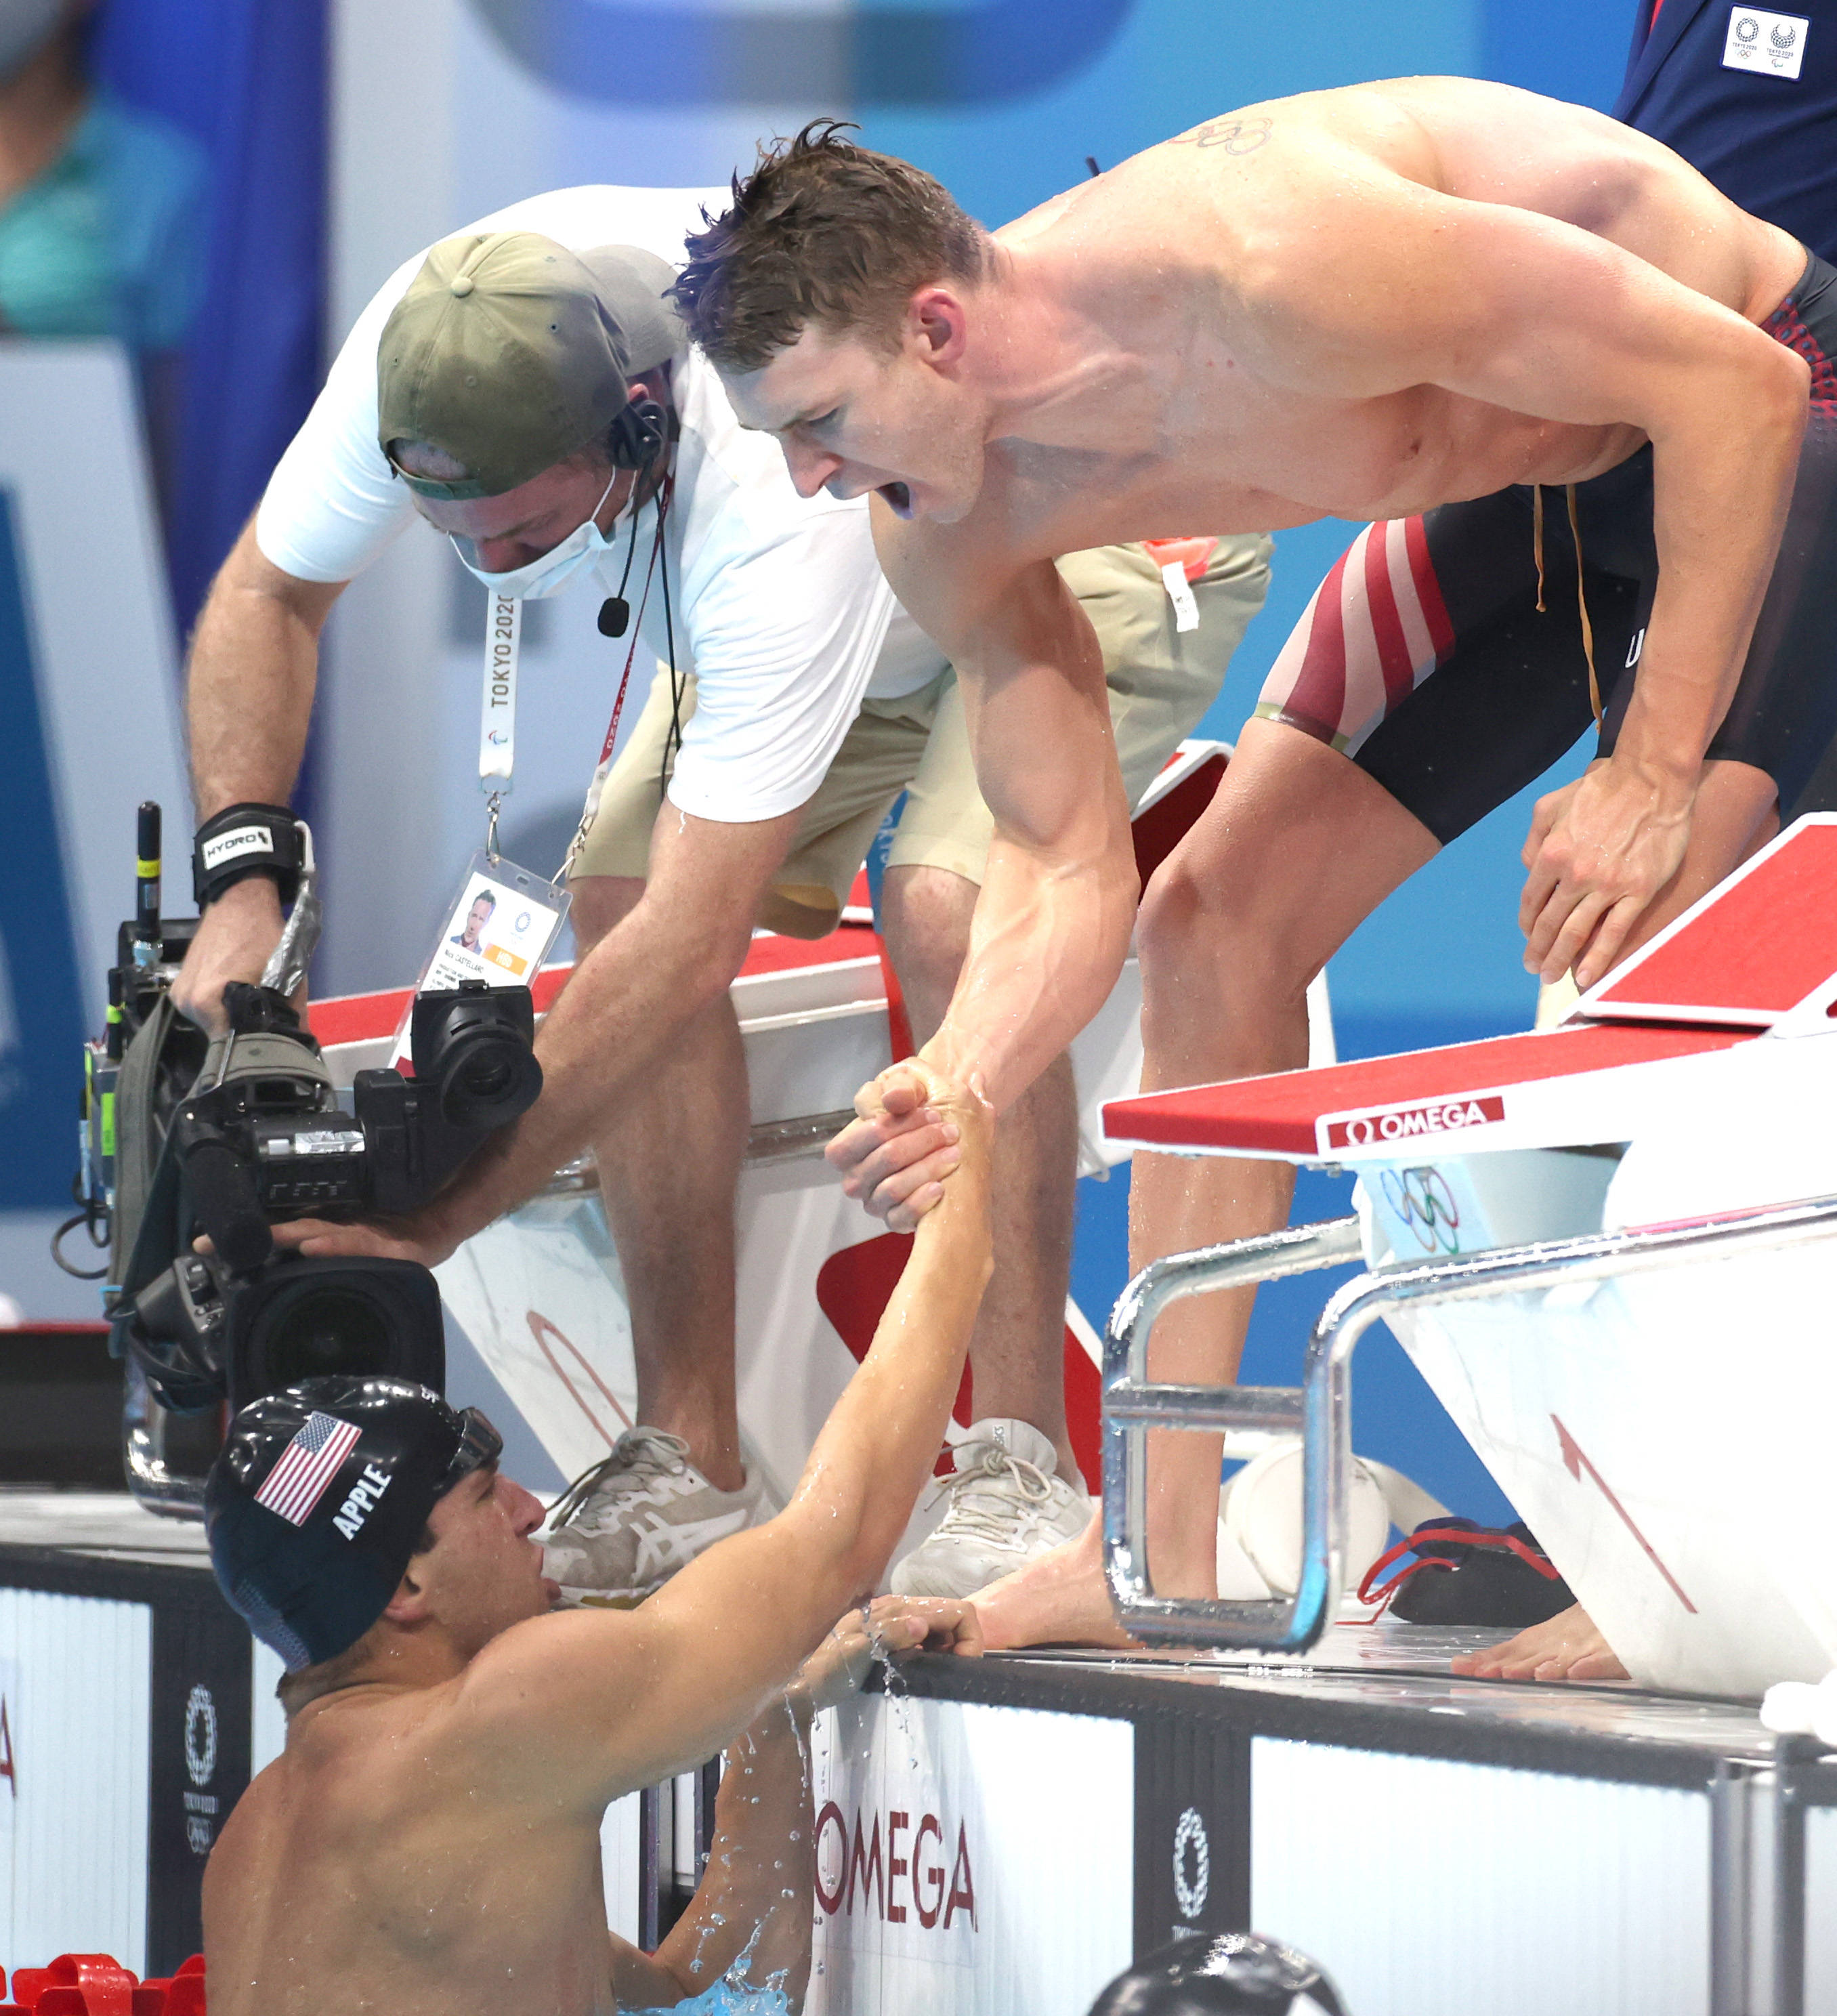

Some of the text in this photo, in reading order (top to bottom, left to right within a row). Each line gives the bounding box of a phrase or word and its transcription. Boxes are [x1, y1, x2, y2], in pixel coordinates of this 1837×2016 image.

[491, 595, 514, 708] TOKYO 2020
[207, 834, 257, 858] HYDRO
[1380, 1101, 1487, 1140] OMEGA
[333, 1463, 392, 1541] APPLE
[814, 1801, 979, 1933] OMEGA
